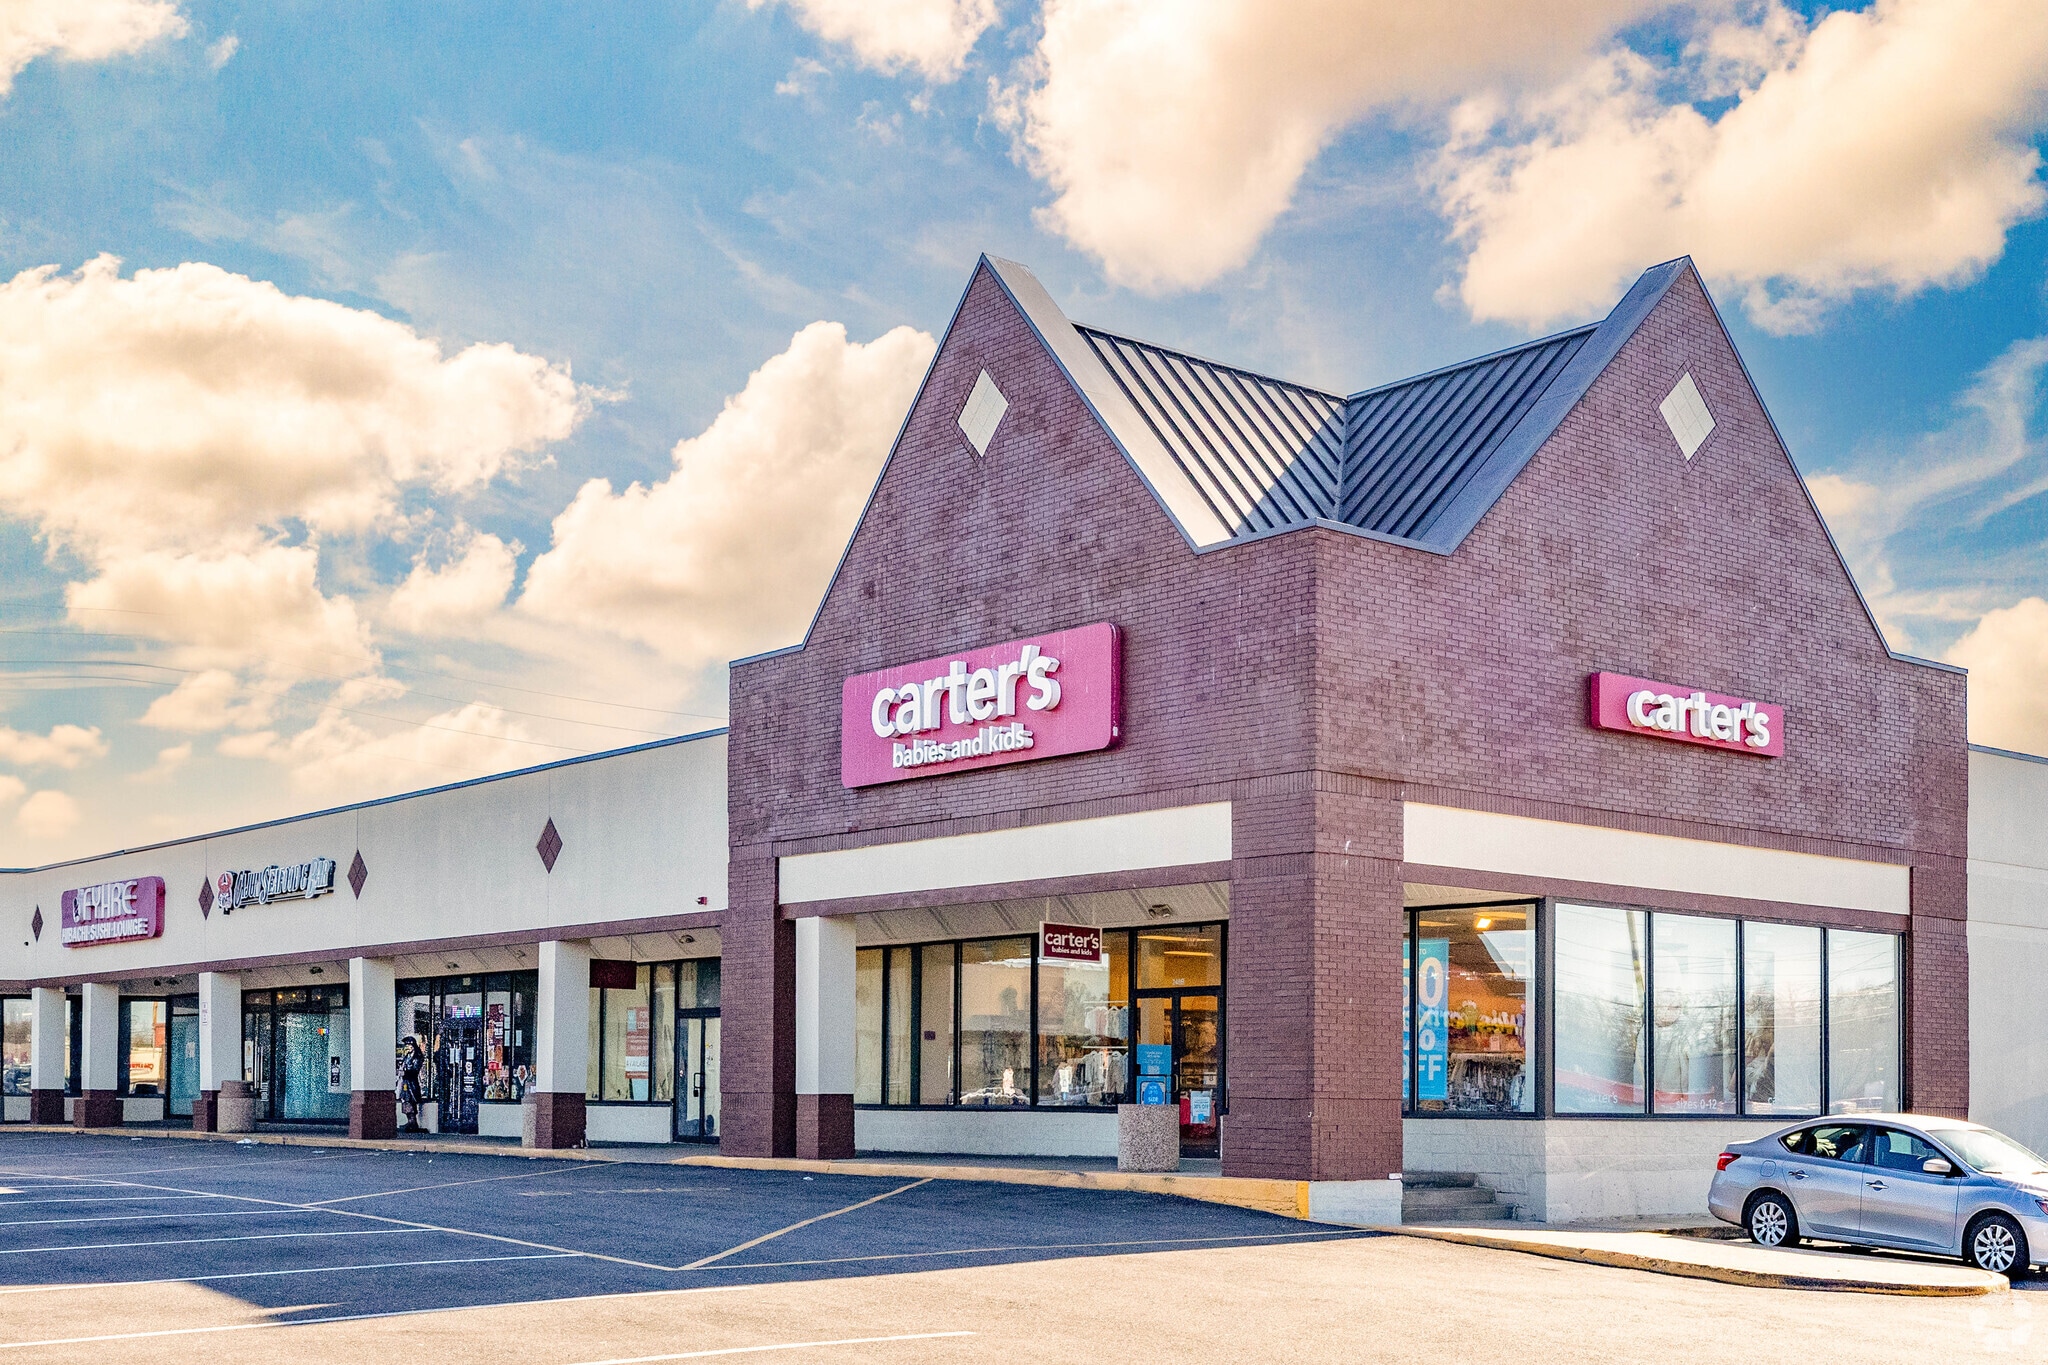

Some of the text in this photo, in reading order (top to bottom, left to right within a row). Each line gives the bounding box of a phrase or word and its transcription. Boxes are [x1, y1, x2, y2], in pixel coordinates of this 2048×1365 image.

[871, 645, 1062, 738] carter's
[1627, 690, 1770, 748] carter's
[893, 722, 1031, 769] babies and kids
[1045, 932, 1100, 949] carter's
[1051, 945, 1070, 954] babies
[1081, 948, 1093, 956] kids
